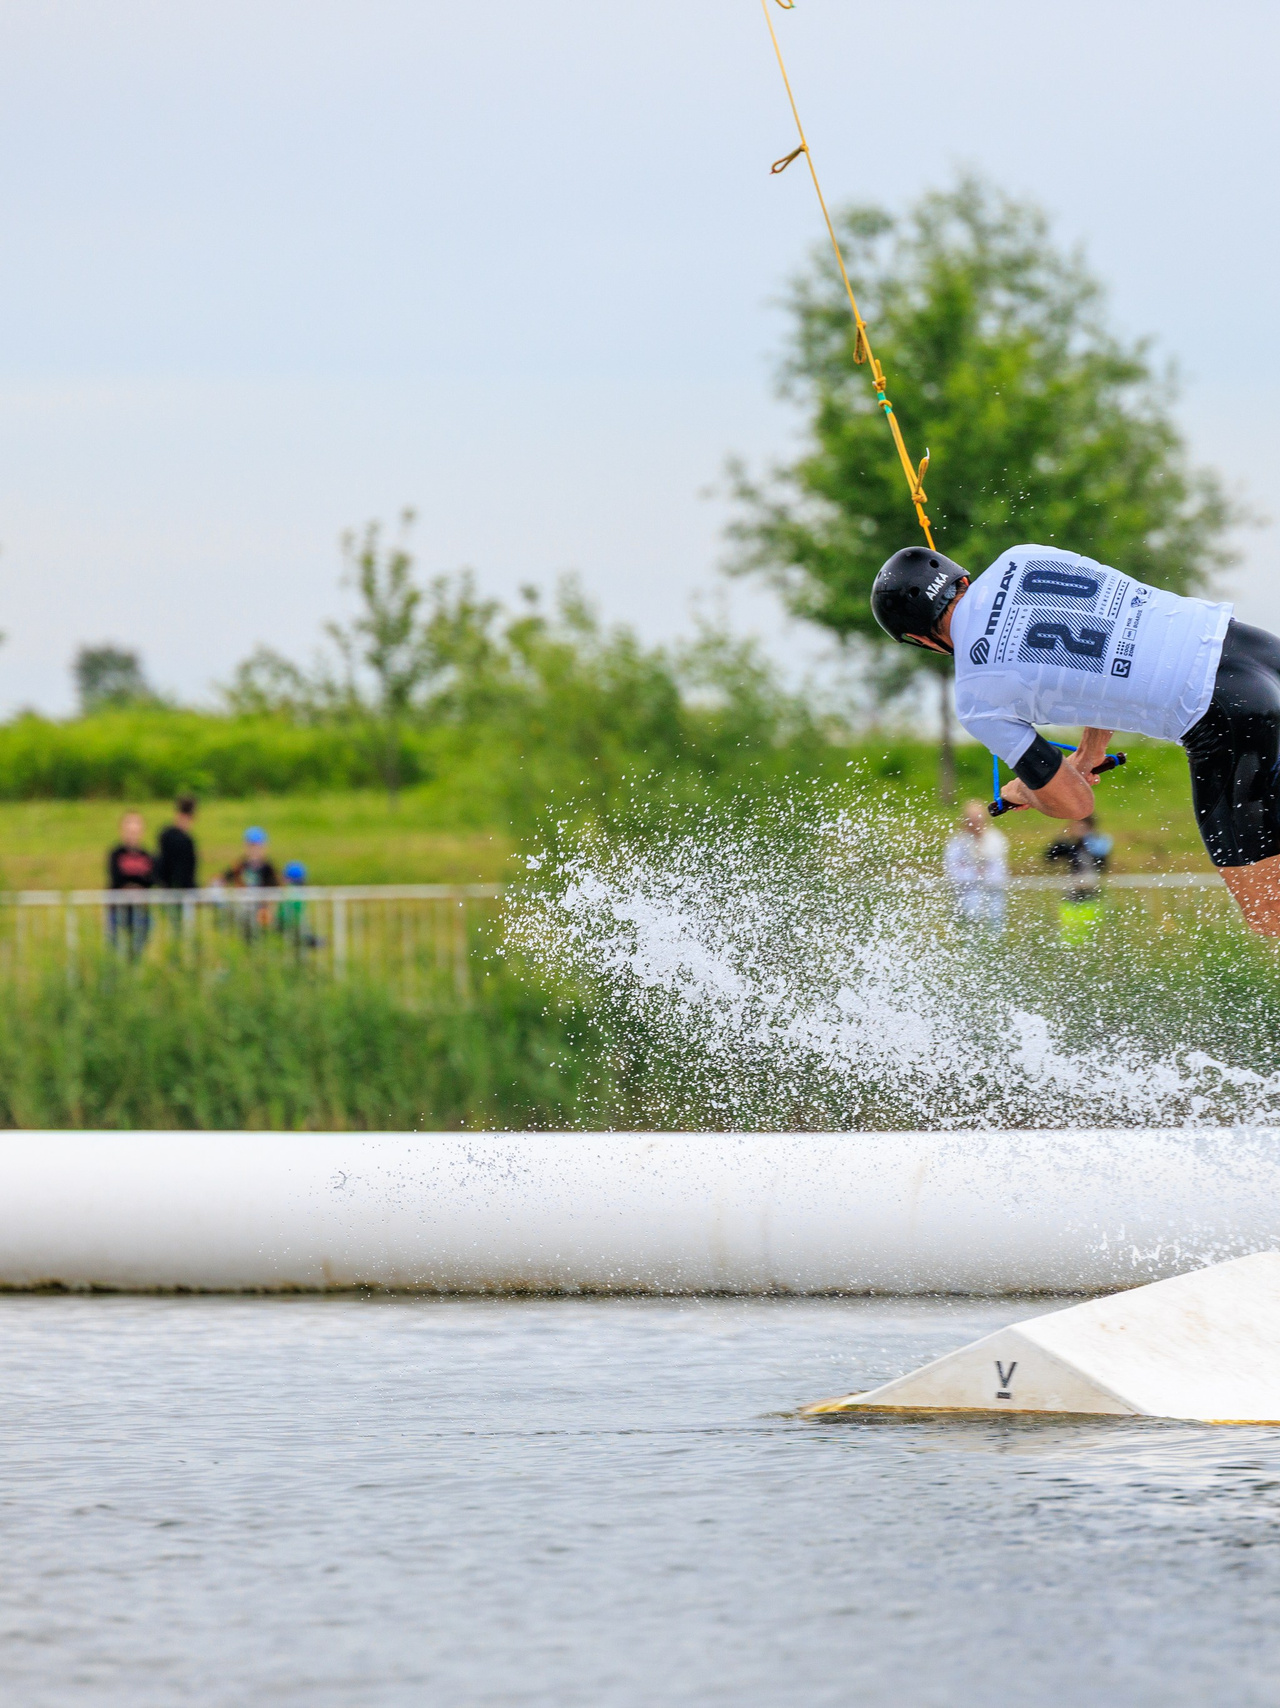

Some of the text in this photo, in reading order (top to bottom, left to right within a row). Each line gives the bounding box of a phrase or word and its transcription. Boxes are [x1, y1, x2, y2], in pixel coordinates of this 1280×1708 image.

[925, 572, 949, 601] ATAKA
[984, 561, 1018, 636] MDAY
[1008, 608, 1029, 662] KUPCHINO
[1022, 570, 1108, 659] 20
[1123, 643, 1131, 657] COOL
[1128, 643, 1136, 657] ZONE
